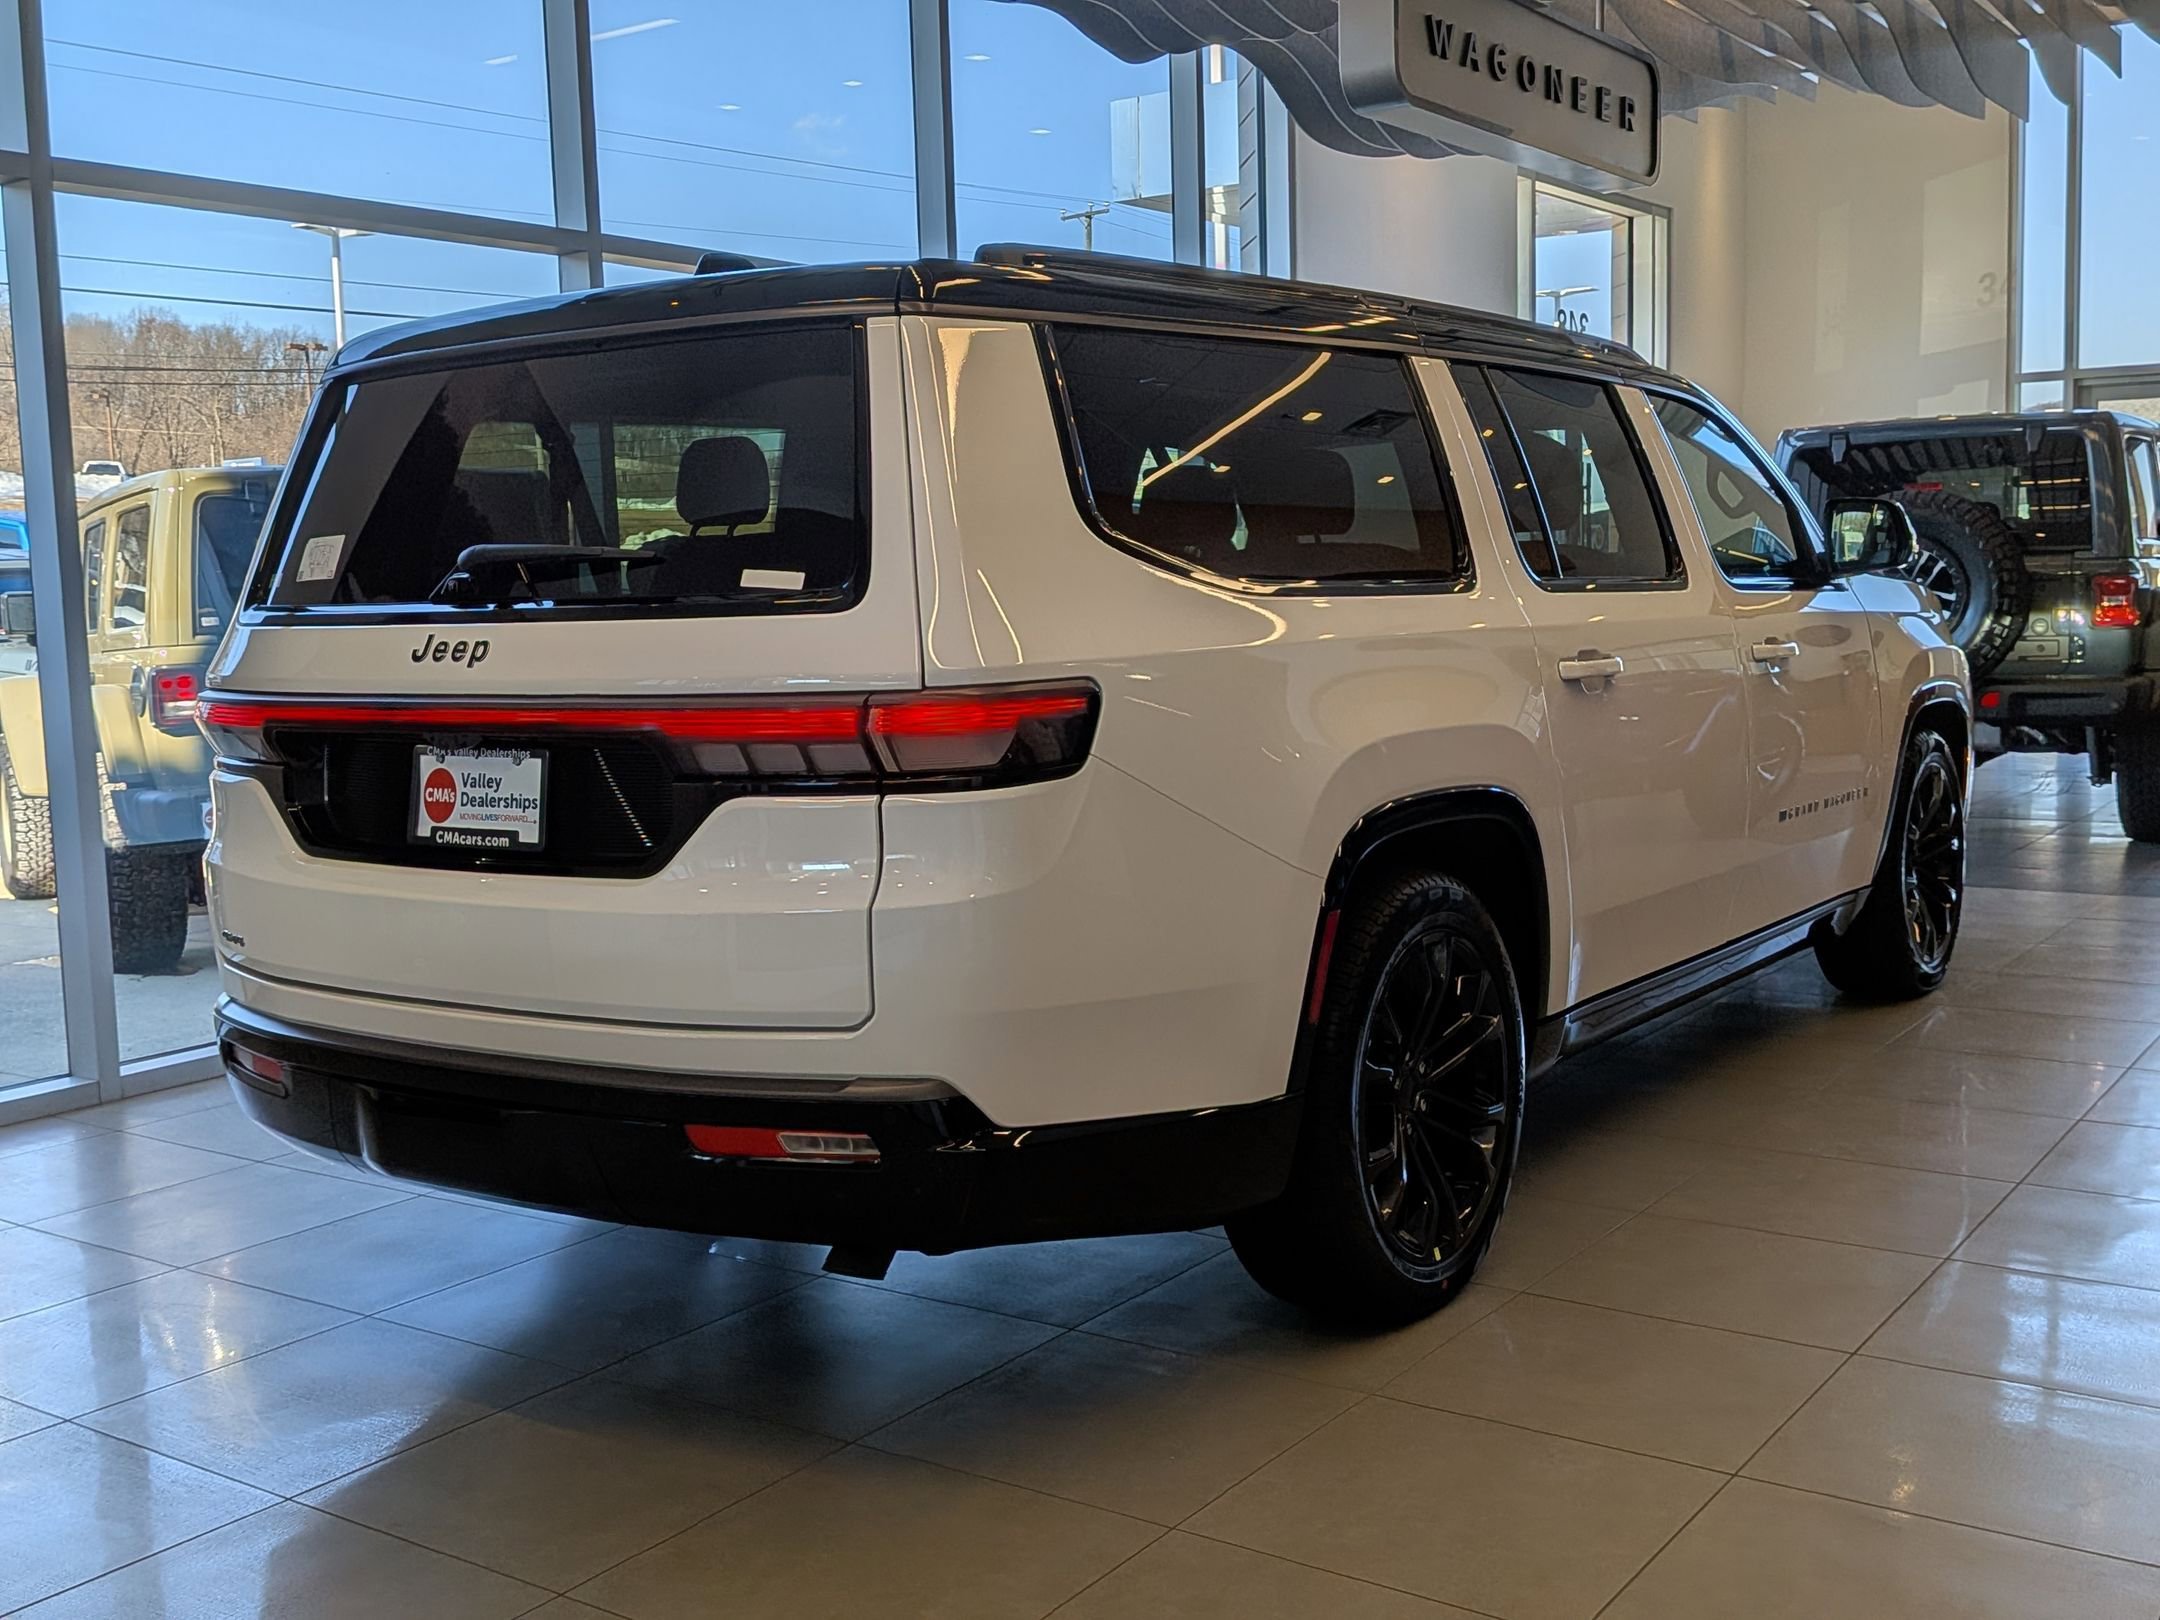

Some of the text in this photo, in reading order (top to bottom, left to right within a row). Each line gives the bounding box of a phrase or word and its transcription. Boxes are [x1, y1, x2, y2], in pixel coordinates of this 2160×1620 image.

[1425, 14, 1636, 132] WAGONEER
[411, 633, 490, 668] Jeep
[427, 746, 451, 757] CMAs
[480, 748, 531, 763] Dealerships
[461, 772, 502, 793] Valley
[425, 787, 455, 803] CMA's
[460, 792, 538, 813] Dealerships
[1788, 787, 1869, 820] GRAND WAGONEER
[435, 830, 510, 847] CMAcars.com
